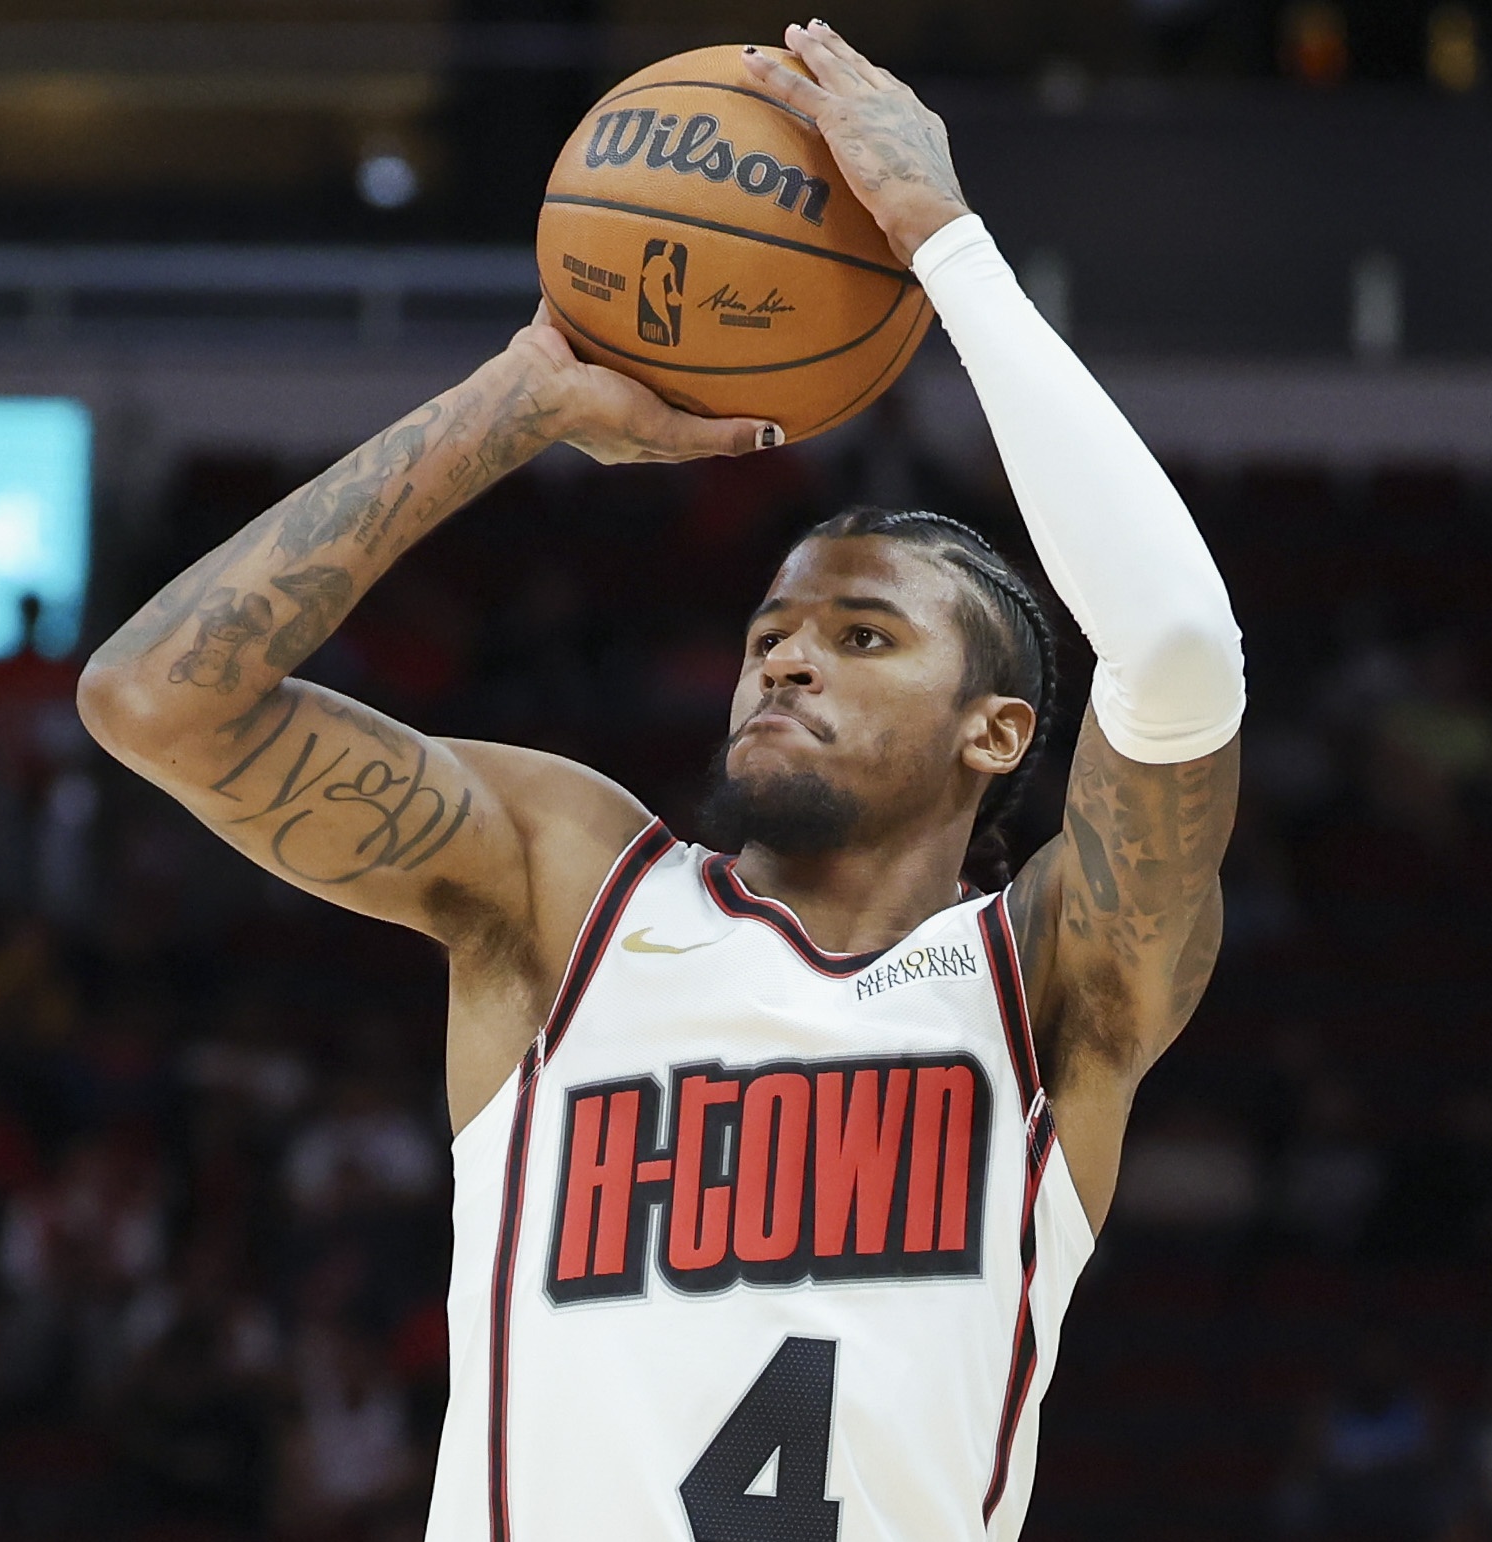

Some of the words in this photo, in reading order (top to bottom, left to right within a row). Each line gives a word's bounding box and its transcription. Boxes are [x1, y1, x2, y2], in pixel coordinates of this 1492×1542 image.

[585, 108, 831, 226] Wilson
[856, 943, 976, 992] MEMORIAL
[857, 957, 977, 1001] HERMANN
